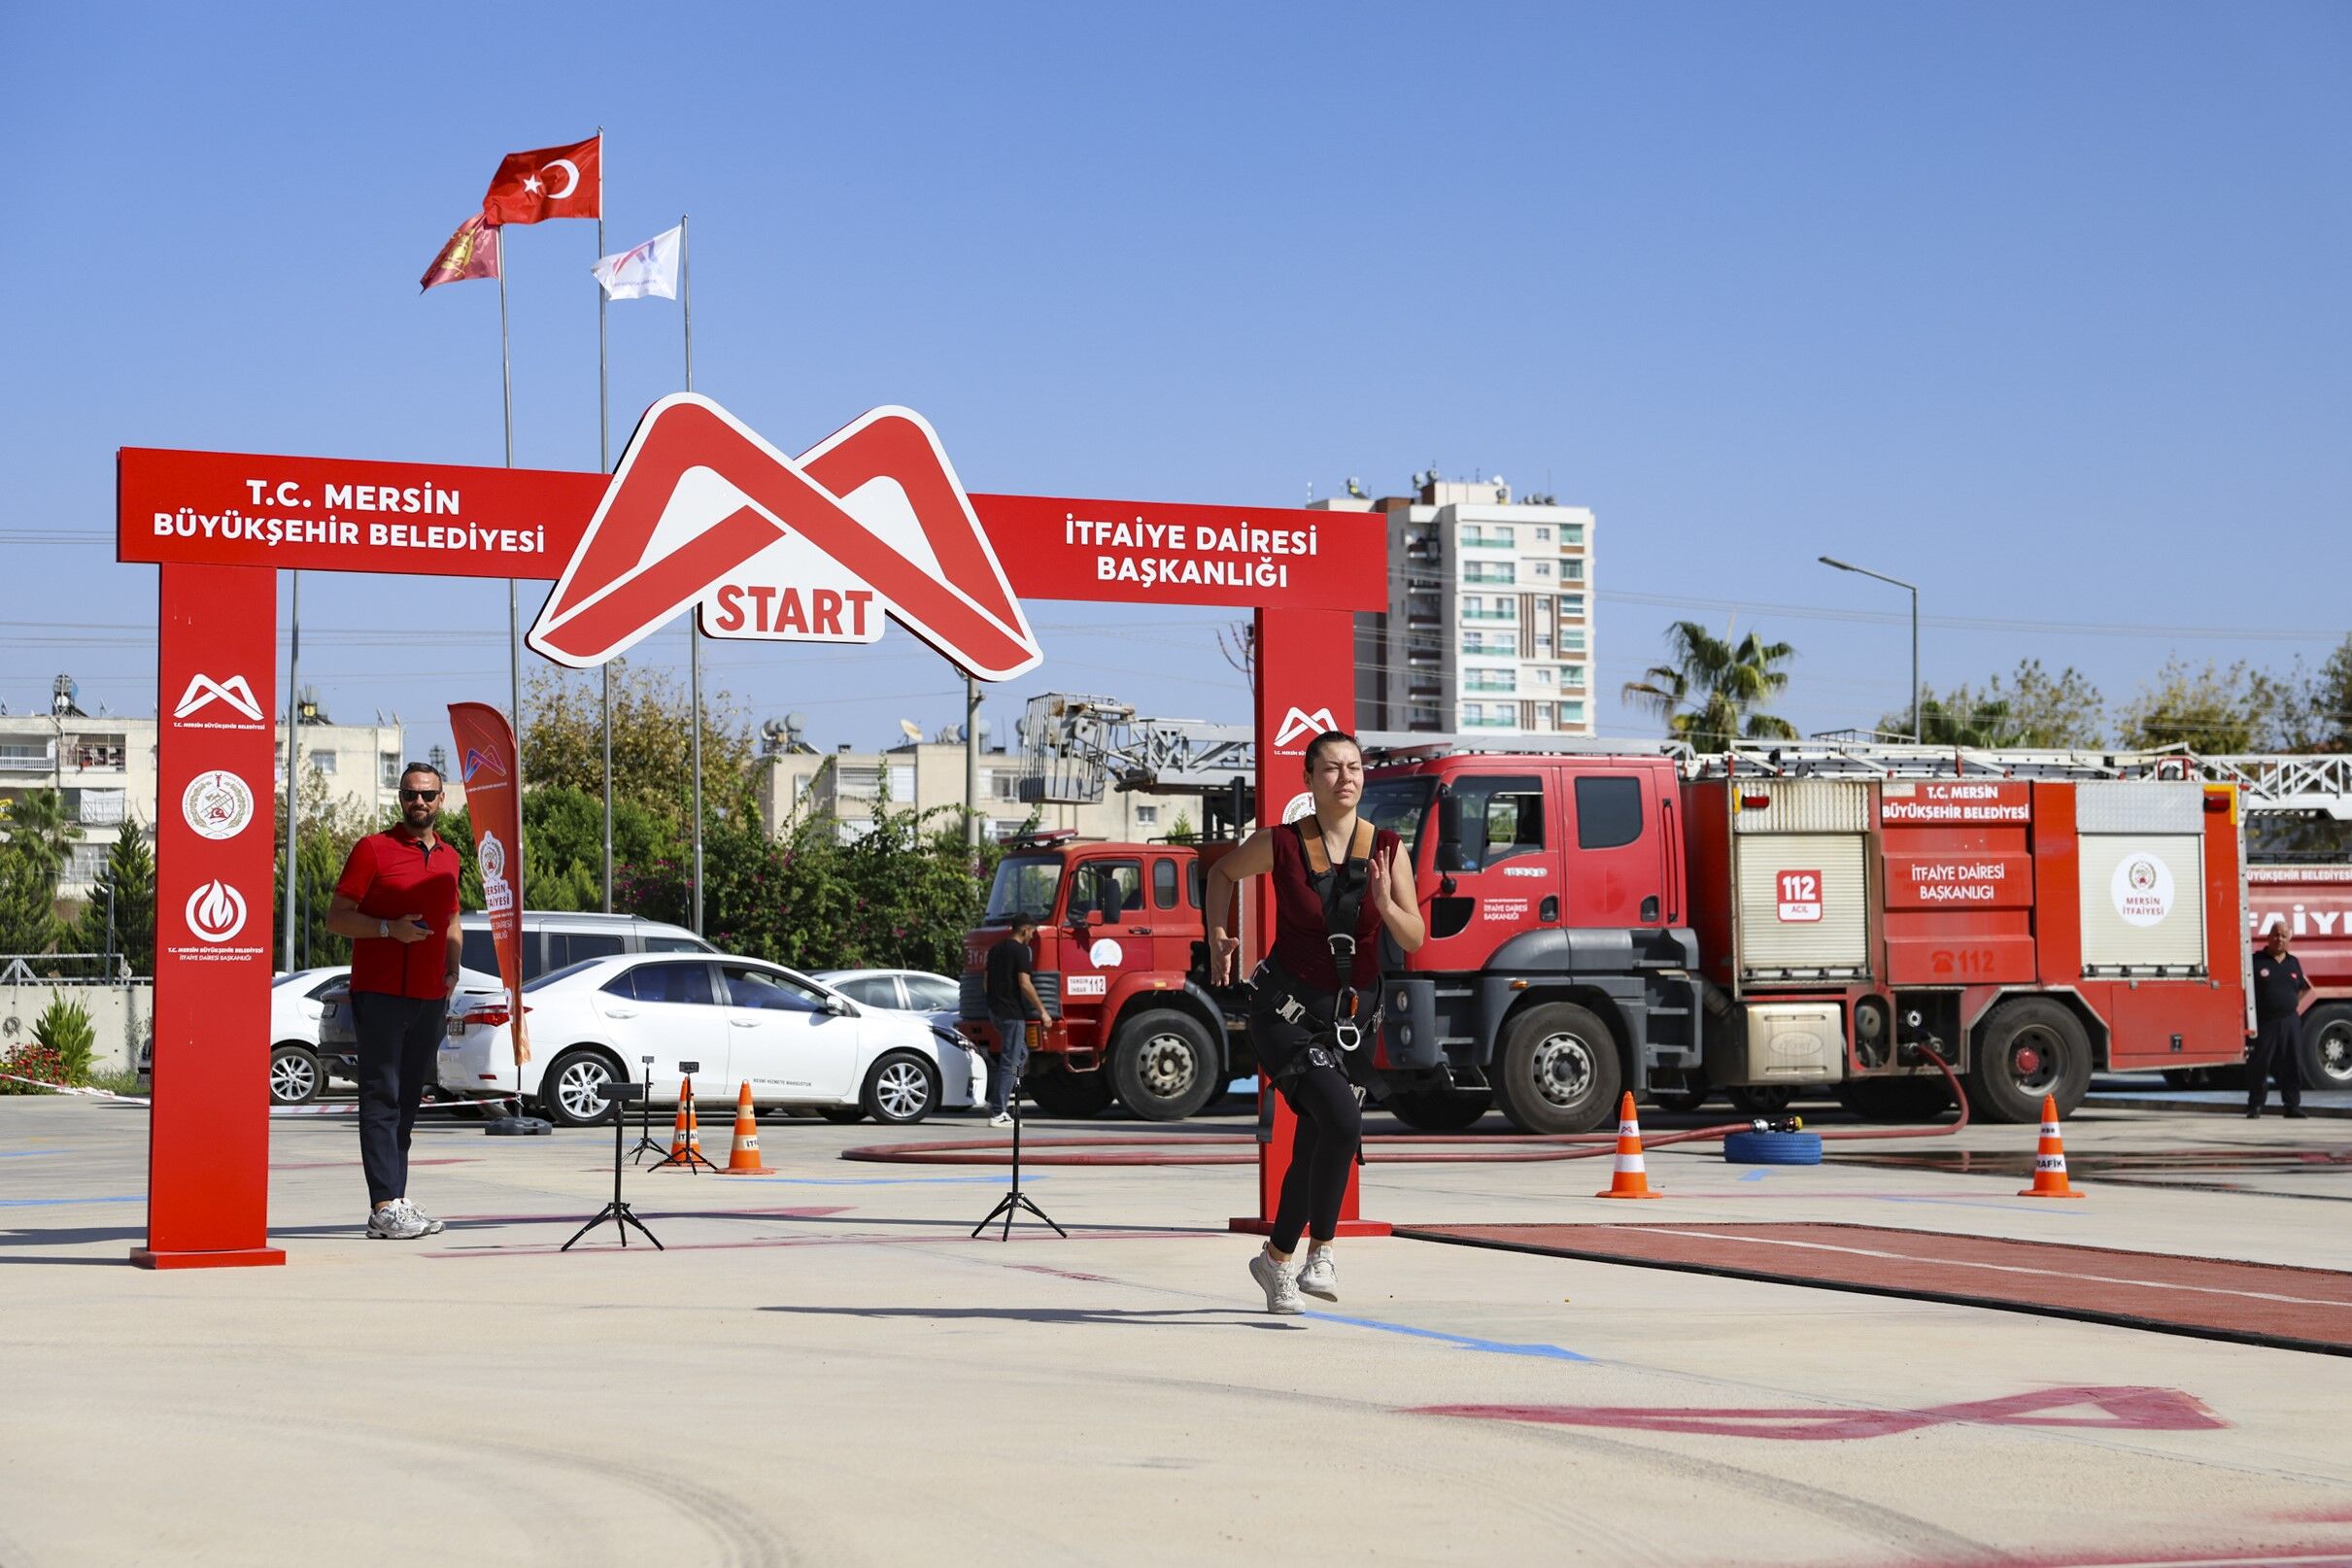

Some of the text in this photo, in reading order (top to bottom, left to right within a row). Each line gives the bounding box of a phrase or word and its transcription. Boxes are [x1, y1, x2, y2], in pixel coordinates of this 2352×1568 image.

[246, 479, 460, 515] T.C. MERSİN
[153, 507, 545, 553] BÜYÜKŞEHİR BELEDİYESİ
[1066, 513, 1316, 555] İTFAİYE DAİRESİ
[1097, 556, 1287, 588] BAŞKANLIĞI
[715, 584, 873, 636] START
[1926, 786, 1948, 799] T.C.
[1951, 784, 1998, 799] MERSİN
[1882, 802, 2029, 820] BÜYÜKŞEHİR BELEDİYESİ
[1911, 863, 2004, 881] İTFAİYE DAİRESİ
[2246, 869, 2300, 882] ÜYÜKŞEHİR
[1782, 875, 1816, 901] 112
[2123, 905, 2164, 915] İTFAİYESİ
[2126, 896, 2160, 905] MERSİN
[1959, 950, 1994, 972] 112
[2036, 1158, 2062, 1168] RAFİK
